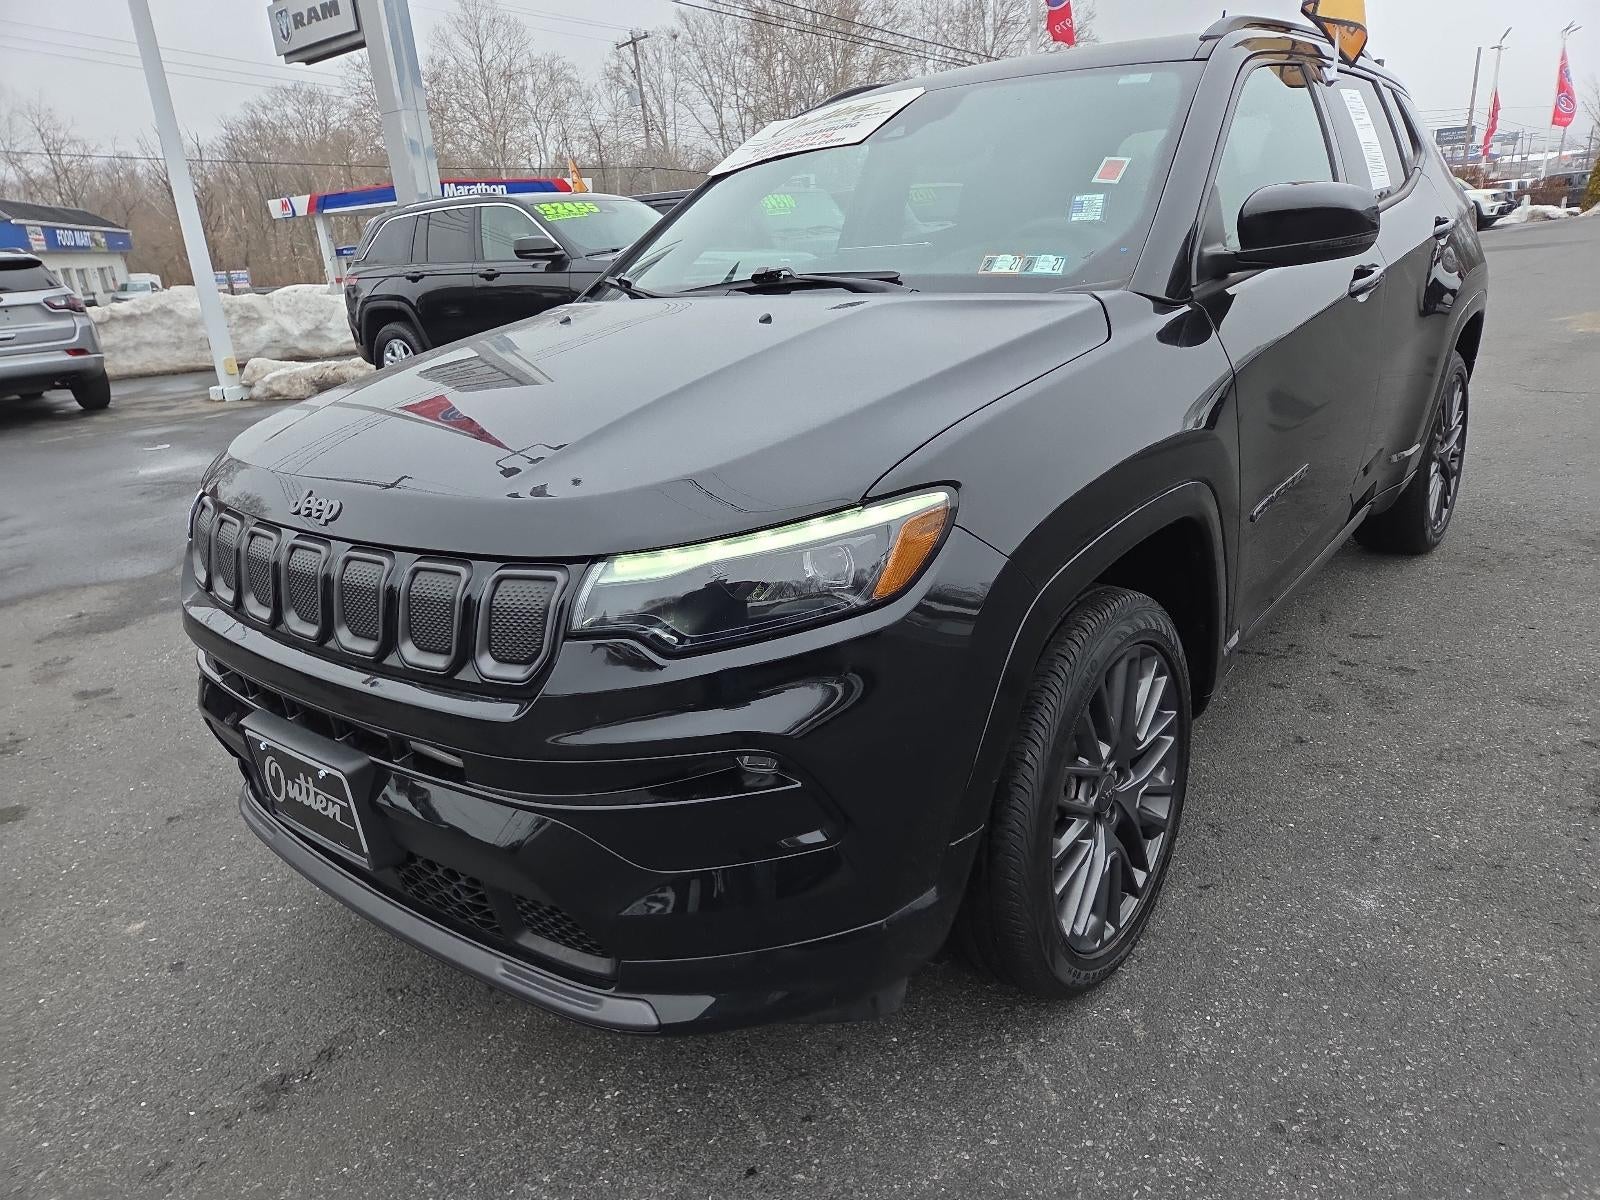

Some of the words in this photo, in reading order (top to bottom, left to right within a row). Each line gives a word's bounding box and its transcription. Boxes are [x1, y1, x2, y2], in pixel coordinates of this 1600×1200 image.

[292, 0, 340, 30] RAM
[443, 182, 508, 197] Marathon
[56, 230, 74, 246] FOOD
[74, 231, 93, 247] MART
[1009, 257, 1022, 271] 27
[1052, 258, 1064, 272] 27
[289, 489, 343, 526] Jeep
[264, 755, 351, 824] Outten
